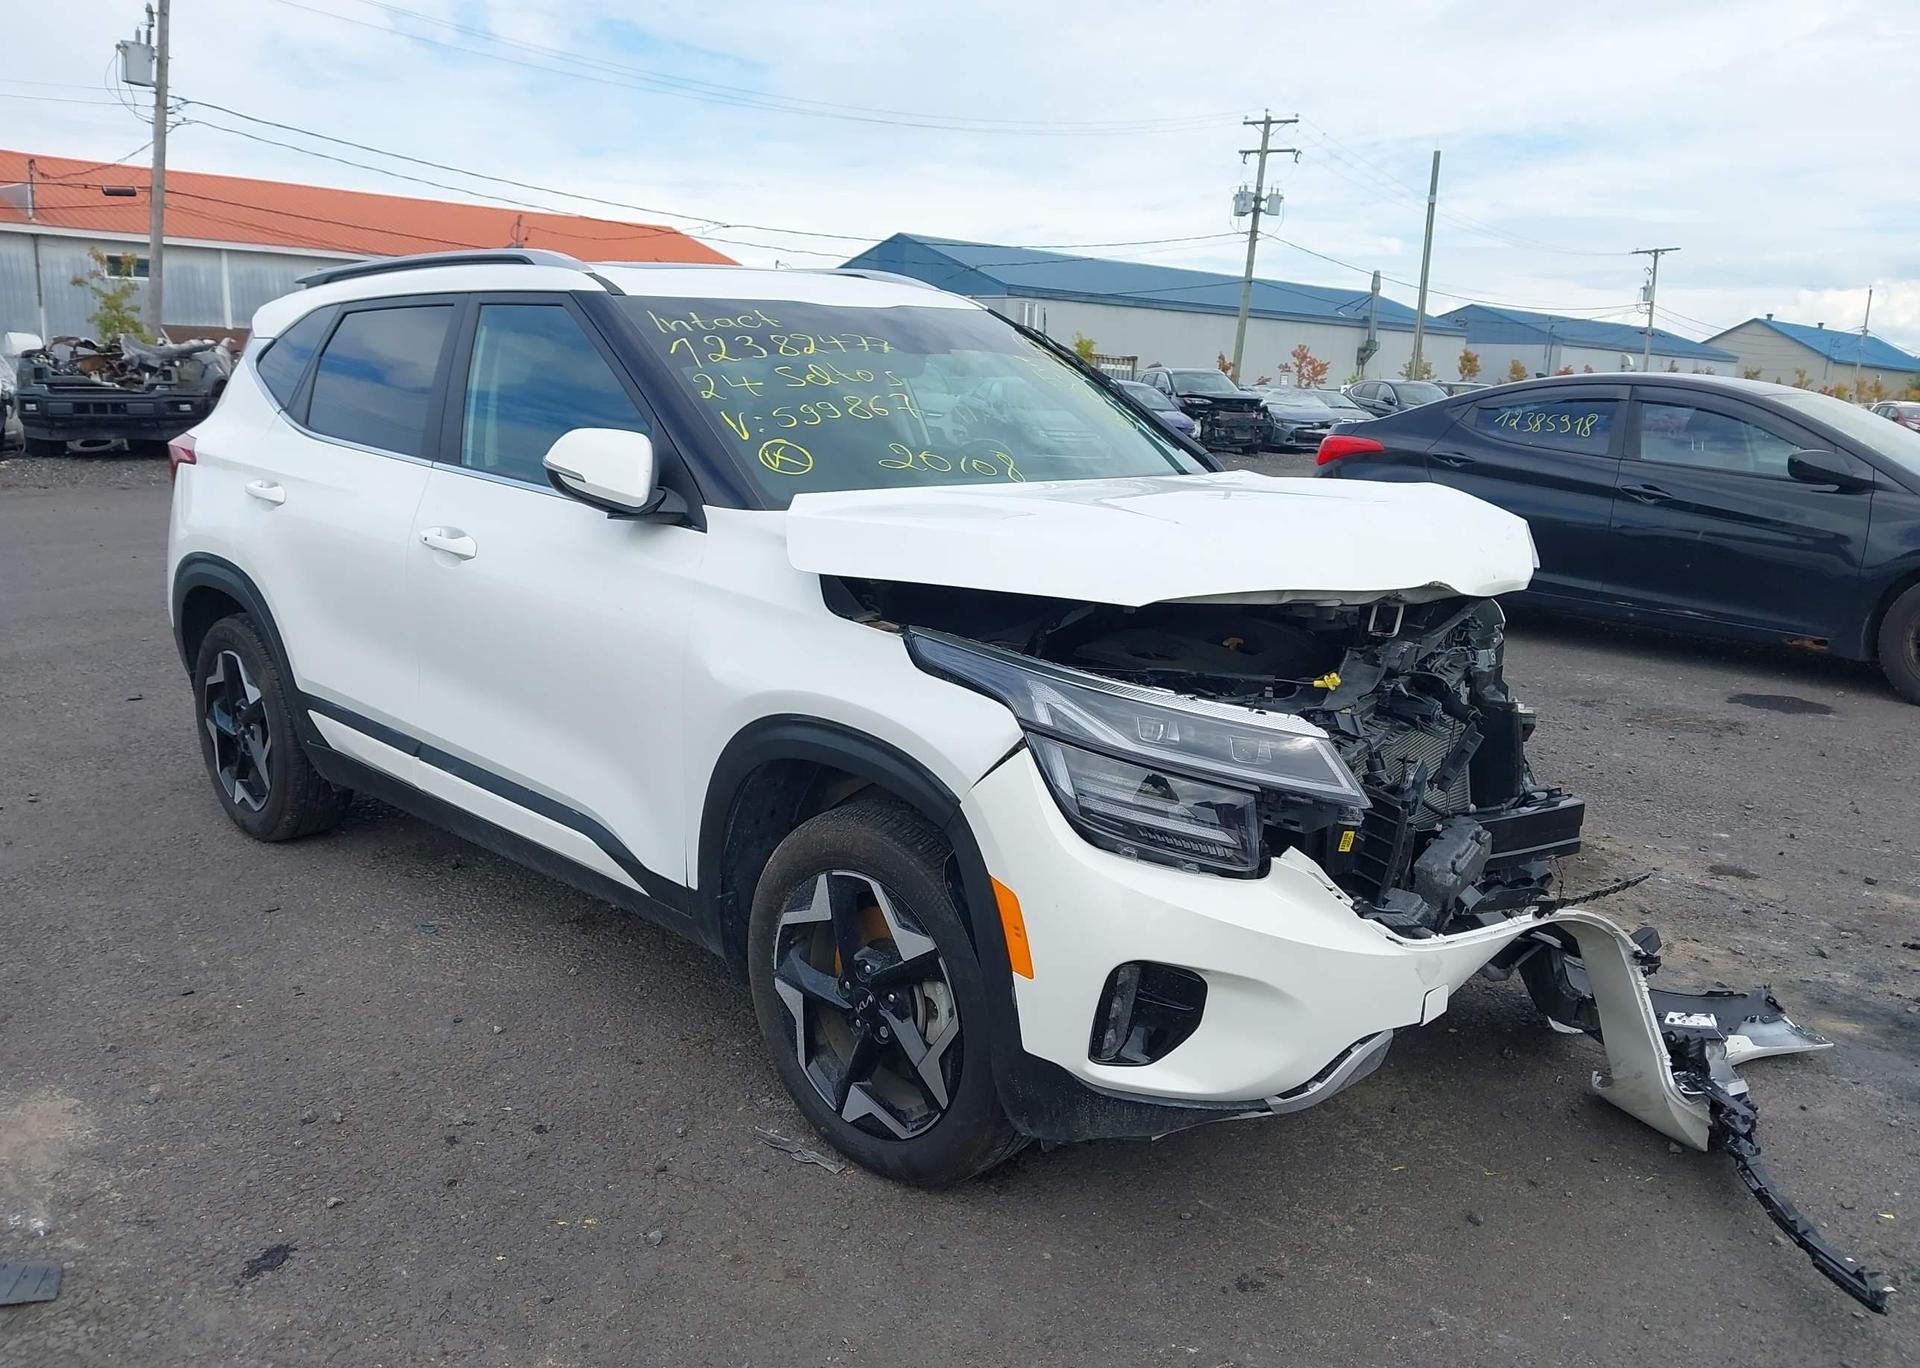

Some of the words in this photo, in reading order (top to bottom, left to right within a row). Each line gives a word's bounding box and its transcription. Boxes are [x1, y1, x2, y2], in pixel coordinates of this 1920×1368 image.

[646, 309, 783, 334] Intact
[669, 334, 896, 369] 12382477
[692, 372, 765, 401] 24
[1494, 408, 1599, 437] 12385918
